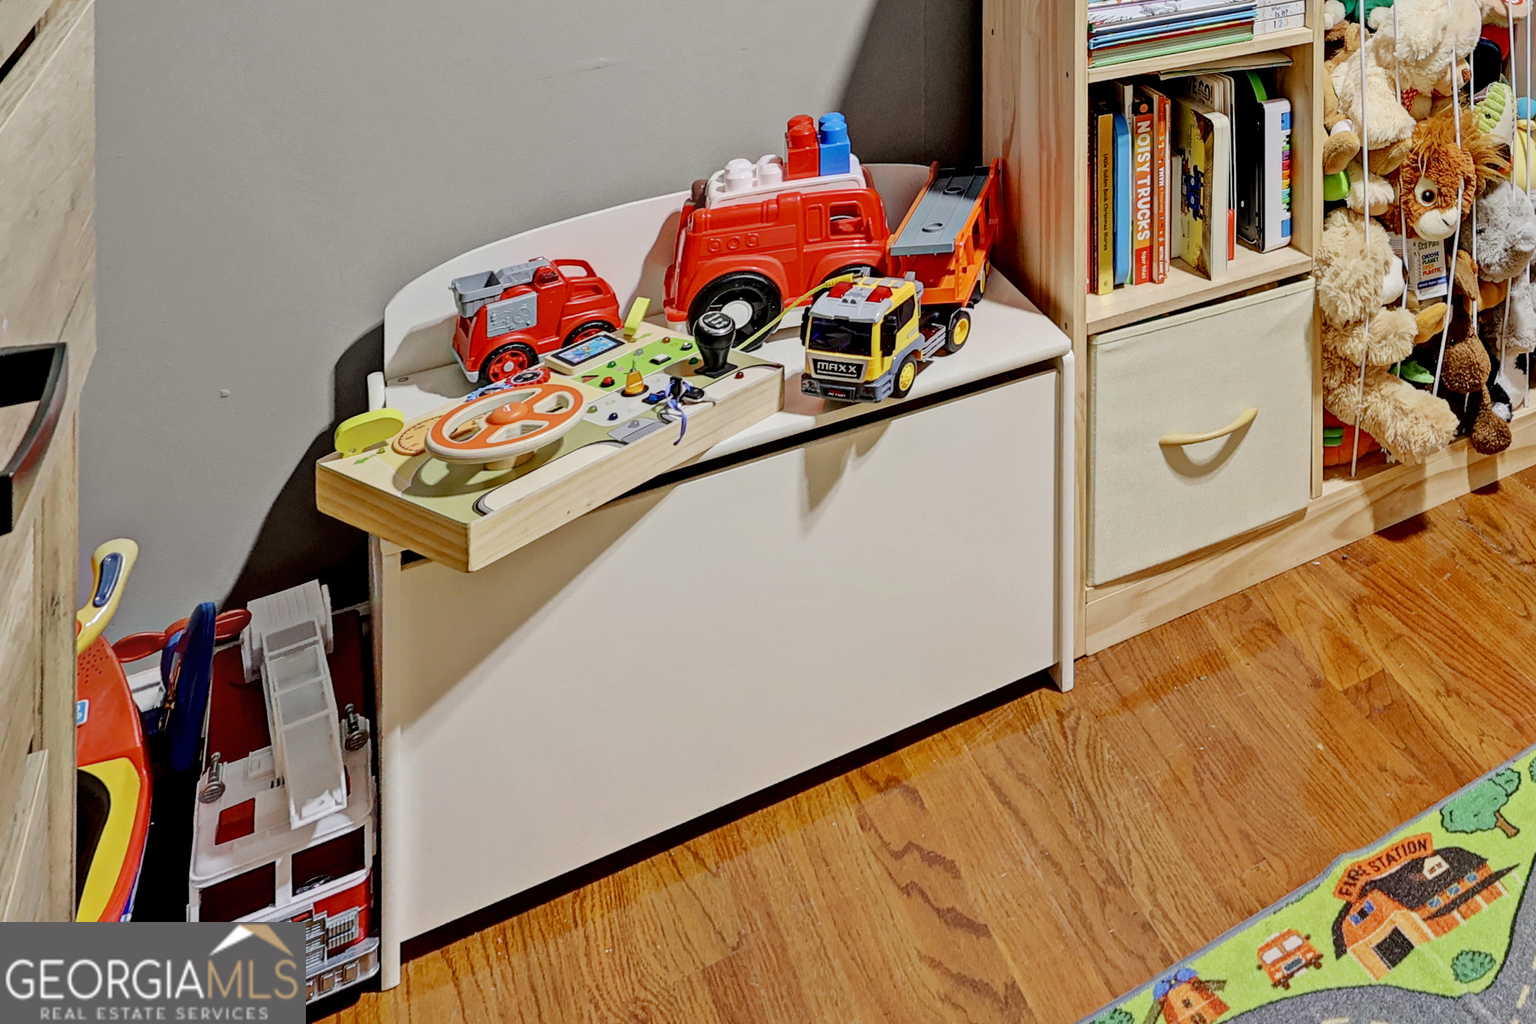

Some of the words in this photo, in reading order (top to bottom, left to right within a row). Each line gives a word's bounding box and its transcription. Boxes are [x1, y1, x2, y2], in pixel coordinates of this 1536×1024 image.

[1284, 18, 1289, 26] 3
[1137, 120, 1151, 173] NOISY
[1137, 175, 1151, 241] TRUCKS
[1422, 257, 1439, 265] PLANET
[1422, 267, 1442, 276] PLASTIC
[817, 361, 857, 373] MAXX
[1339, 865, 1371, 896] FIRE
[1368, 839, 1427, 872] STATION
